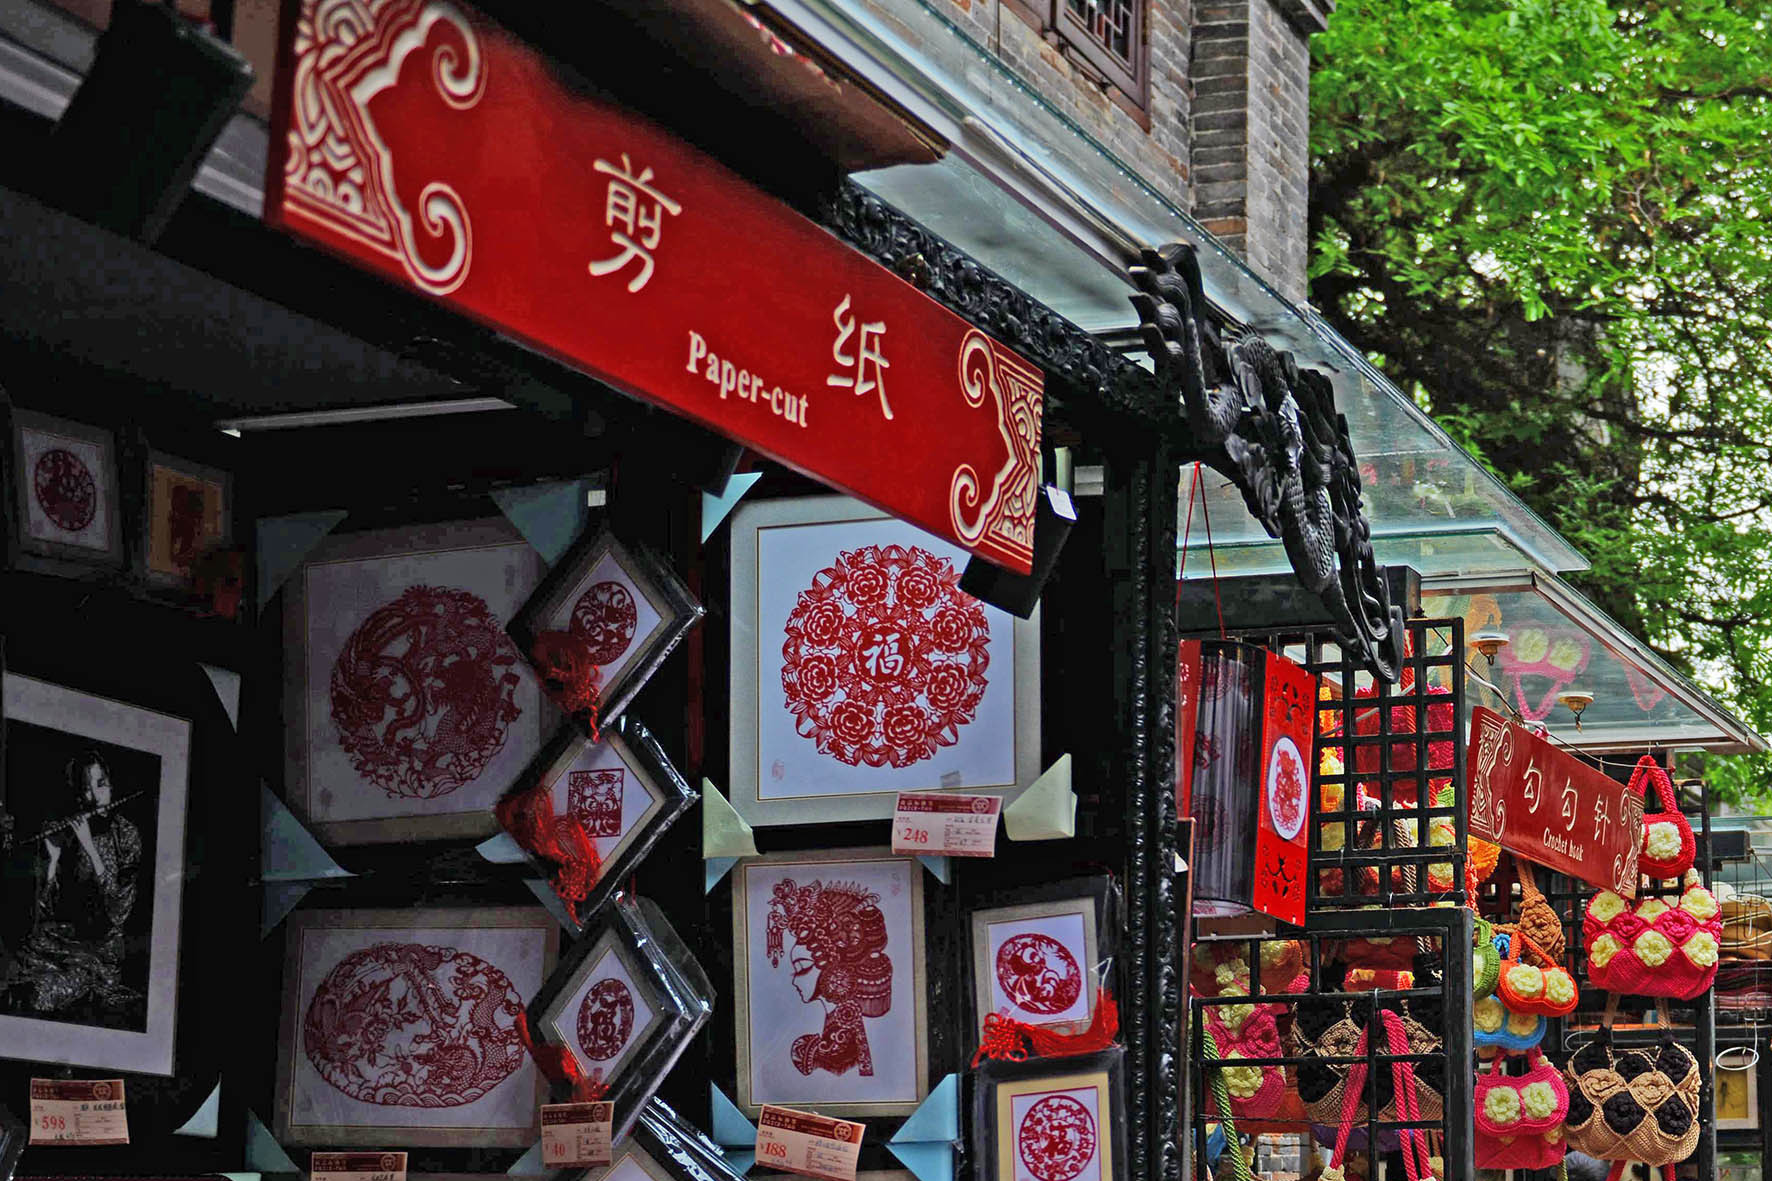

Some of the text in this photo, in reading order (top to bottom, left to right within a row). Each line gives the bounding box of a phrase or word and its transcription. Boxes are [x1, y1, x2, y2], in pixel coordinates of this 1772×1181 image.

[589, 153, 894, 419] 剪纸
[686, 330, 808, 427] Paper-cut
[863, 633, 904, 678] 福
[1523, 756, 1611, 846] 勾勾针
[903, 828, 928, 843] 248
[1544, 827, 1567, 854] Crochet
[42, 1116, 66, 1130] 598
[765, 1142, 788, 1158] 188
